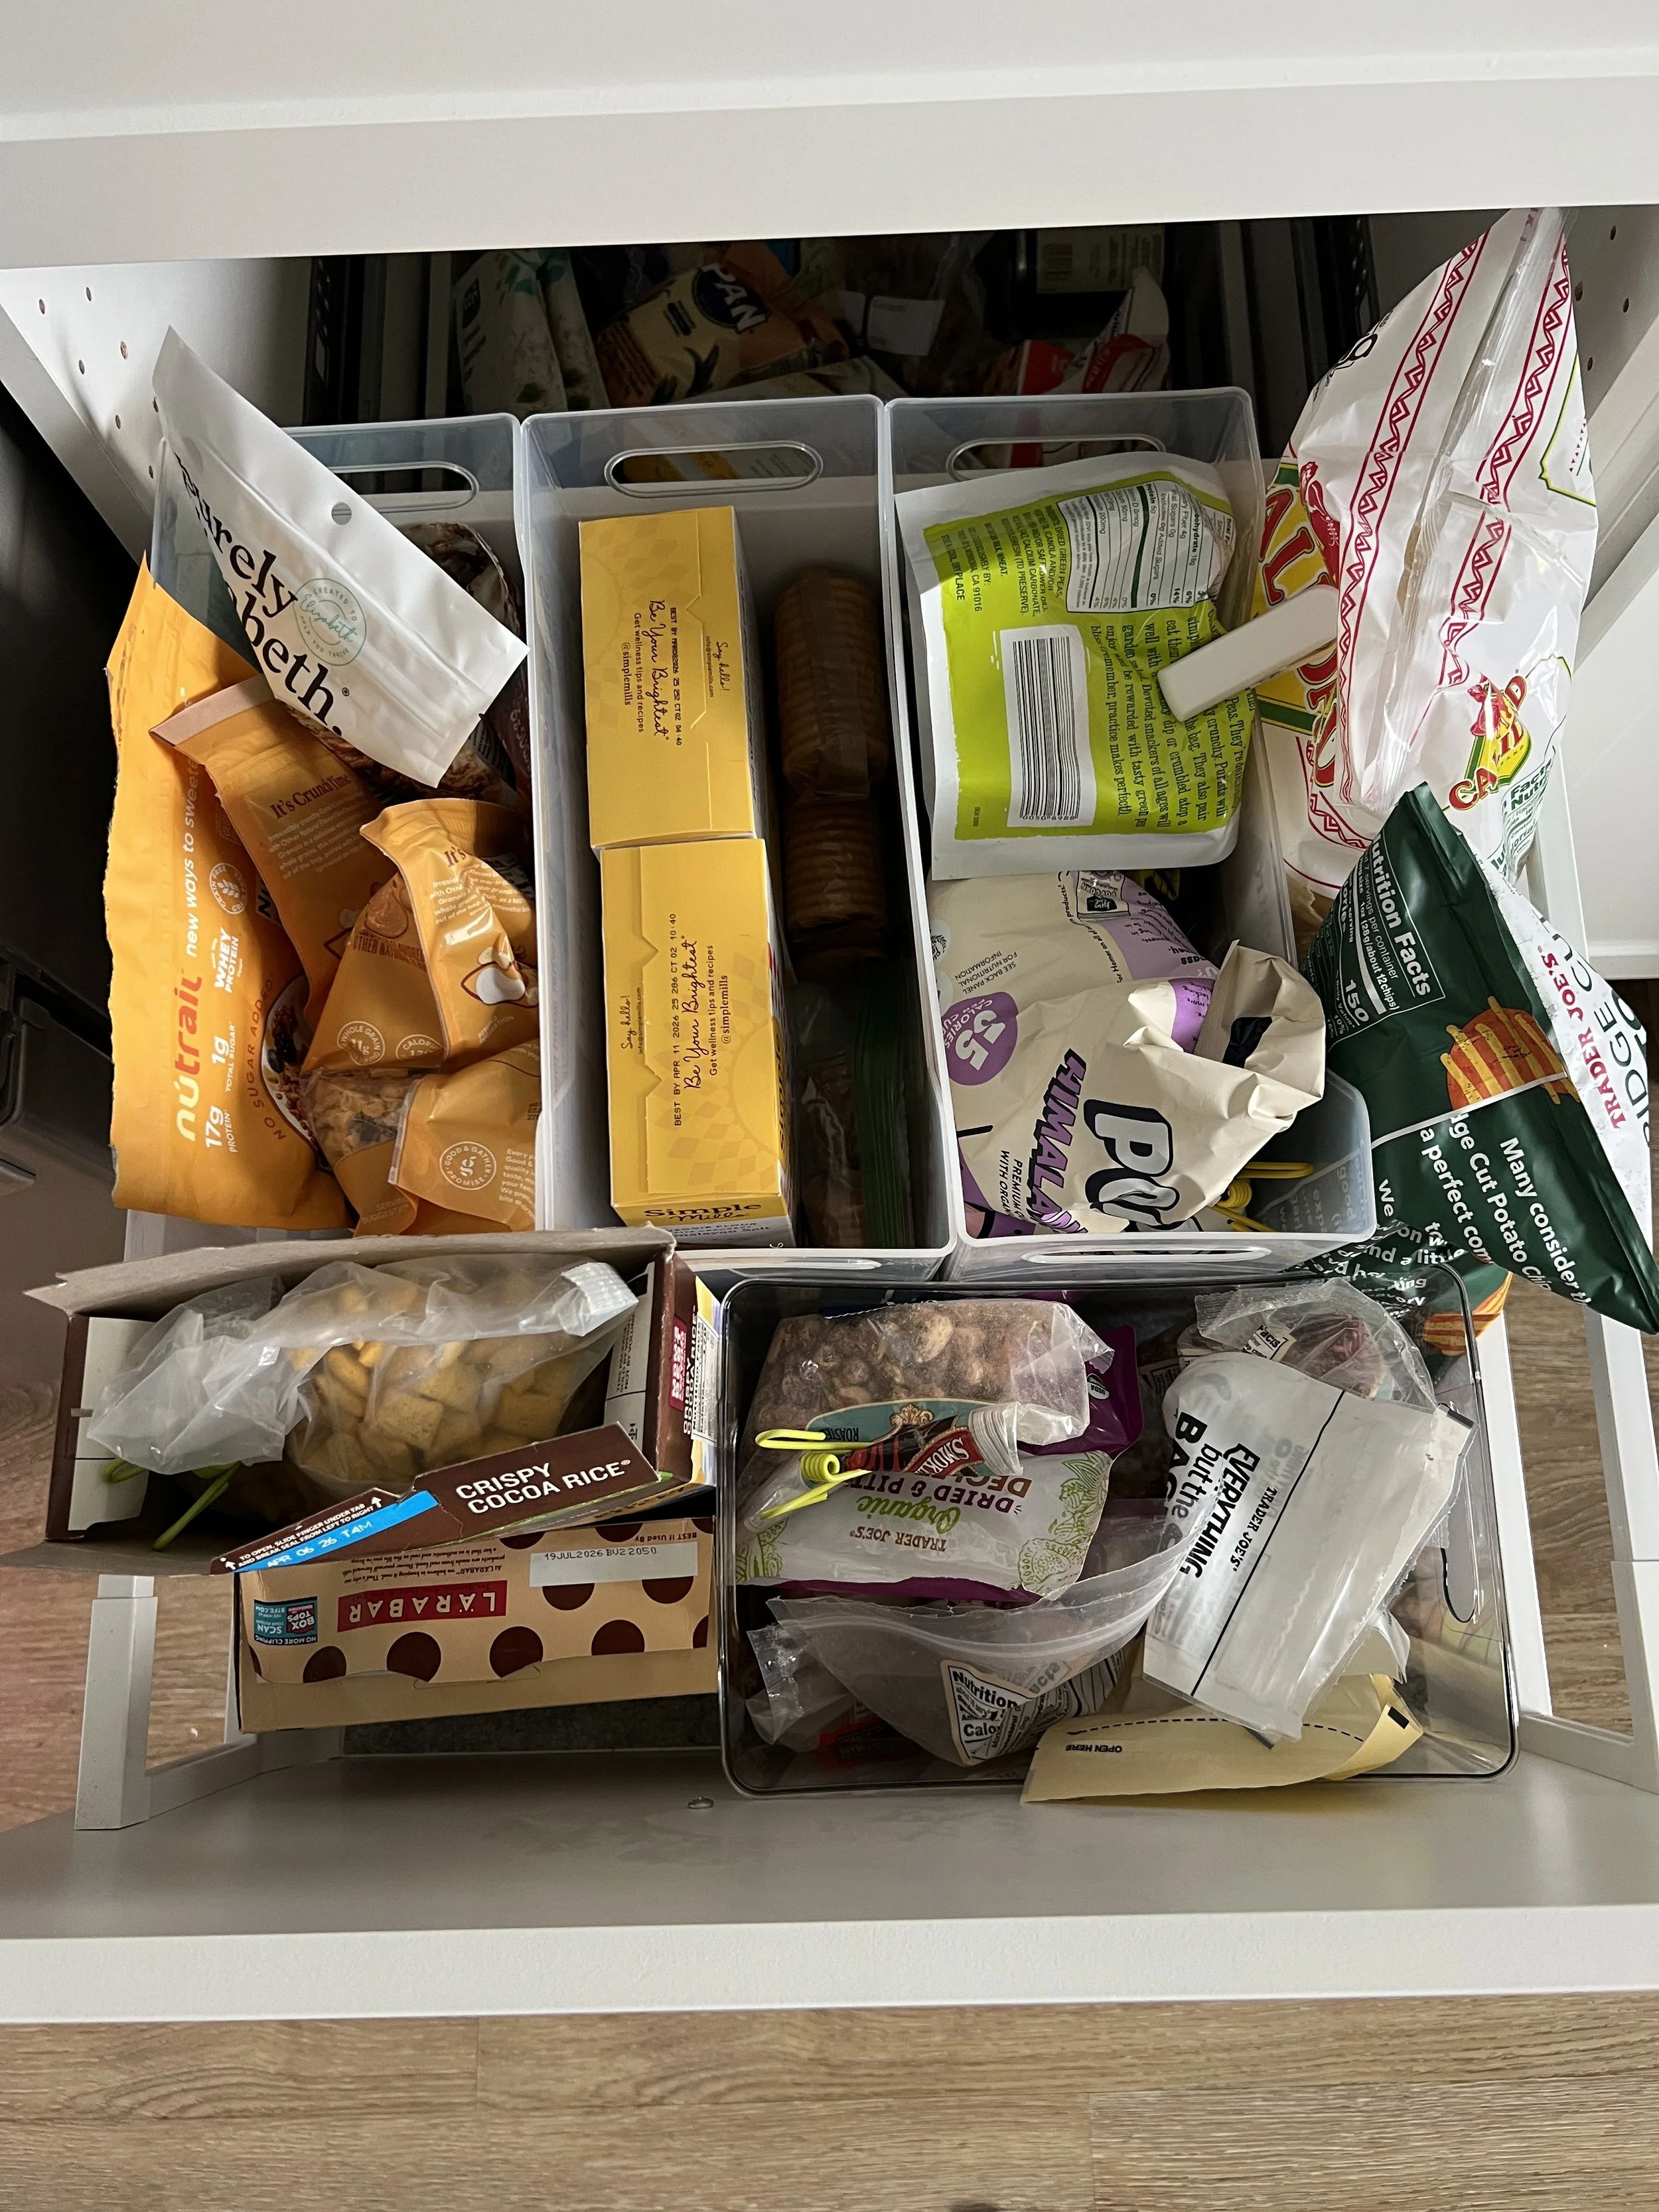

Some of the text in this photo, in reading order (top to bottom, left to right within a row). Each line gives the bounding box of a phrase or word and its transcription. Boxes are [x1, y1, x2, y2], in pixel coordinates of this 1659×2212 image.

[1059, 549, 1068, 574] GREEN
[955, 572, 965, 601] PLACE
[972, 575, 982, 612] CA 91016
[1029, 567, 1041, 617] CARBONATE,
[649, 600, 665, 622] Be
[1166, 620, 1181, 636] eat
[634, 630, 643, 665] wellness
[642, 623, 666, 663] Your
[713, 642, 728, 661] Say
[1145, 622, 1163, 668] well with
[622, 642, 634, 705] @simplemills
[1122, 625, 1169, 812] garden Devoted snackers of all ages
[1106, 701, 1125, 776] practice makes
[1123, 670, 1149, 817] be rewarded with tasty green
[1207, 719, 1225, 761] crunchy.
[1163, 720, 1192, 818] dip or crumbled atop
[1193, 752, 1210, 822] They also pair
[444, 846, 467, 867] It's
[183, 832, 199, 957] new ways to
[1364, 873, 1399, 980] servings per container
[1372, 834, 1431, 996] utrition Facts
[214, 926, 232, 988] WHEY
[225, 936, 239, 994] PROTEIN
[706, 945, 715, 978] recipes
[954, 950, 1002, 981] INFORMATION
[959, 951, 1018, 987] FOR NUTRITIONAL
[1100, 942, 1119, 973] Homer on
[707, 980, 715, 996] and
[962, 961, 1017, 994] SEE BACK PANEL
[672, 998, 679, 1010] 25
[707, 999, 717, 1015] tips
[719, 975, 732, 1045] @simplemills
[1345, 979, 1370, 1022] 150
[212, 1035, 229, 1065] 1g
[341, 1025, 381, 1051] WHOLE GRAIN
[621, 1028, 637, 1049] Say
[673, 1045, 680, 1054] 11
[683, 1019, 709, 1062] Your
[955, 1009, 1006, 1071] 55
[226, 1062, 235, 1092] TOTAL
[246, 1045, 265, 1108] SUGAR
[674, 1083, 681, 1095] BY
[684, 1065, 701, 1088] Be
[1577, 1027, 1626, 1129] TRADER
[205, 1105, 224, 1149] 17g
[264, 1117, 287, 1141] NO
[444, 1146, 492, 1175] GOOD GATHER
[447, 1169, 485, 1187] PROMISE
[999, 1149, 1010, 1179] WITH
[1419, 1128, 1474, 1223] a perfect
[1011, 1158, 1023, 1209] PREMIUM
[1378, 1179, 1395, 1217] We
[644, 1204, 761, 1217] Simple
[1469, 1153, 1528, 1263] Cut Potato
[1500, 1137, 1580, 1290] Many consider
[455, 1462, 551, 1500] CRISPY
[467, 1481, 561, 1514] COCOA
[910, 1481, 1016, 1514] DRIED &
[1172, 1443, 1223, 1518] but the
[856, 1495, 962, 1534] Organic
[1247, 1487, 1277, 1532] TRADER
[238, 1506, 374, 1568] AND BREAK SEAL FROM LEFT TO RIGHT
[250, 1544, 275, 1557] OPEN,
[275, 1534, 297, 1546] SLIDE
[297, 1522, 325, 1536] FINGER
[324, 1510, 350, 1525] UNDER
[349, 1503, 366, 1514] TAB
[267, 1520, 372, 1568] APR 06 26 T4M
[634, 1532, 697, 1542] BEST Used By
[895, 1532, 947, 1552] TRADER
[544, 1546, 658, 1561] 19JUL2026 BV2 2050
[257, 1623, 282, 1634] SCAN
[287, 1611, 311, 1623] TOPS
[291, 1616, 315, 1630] BOX
[952, 1670, 1017, 1708] Nutrition
